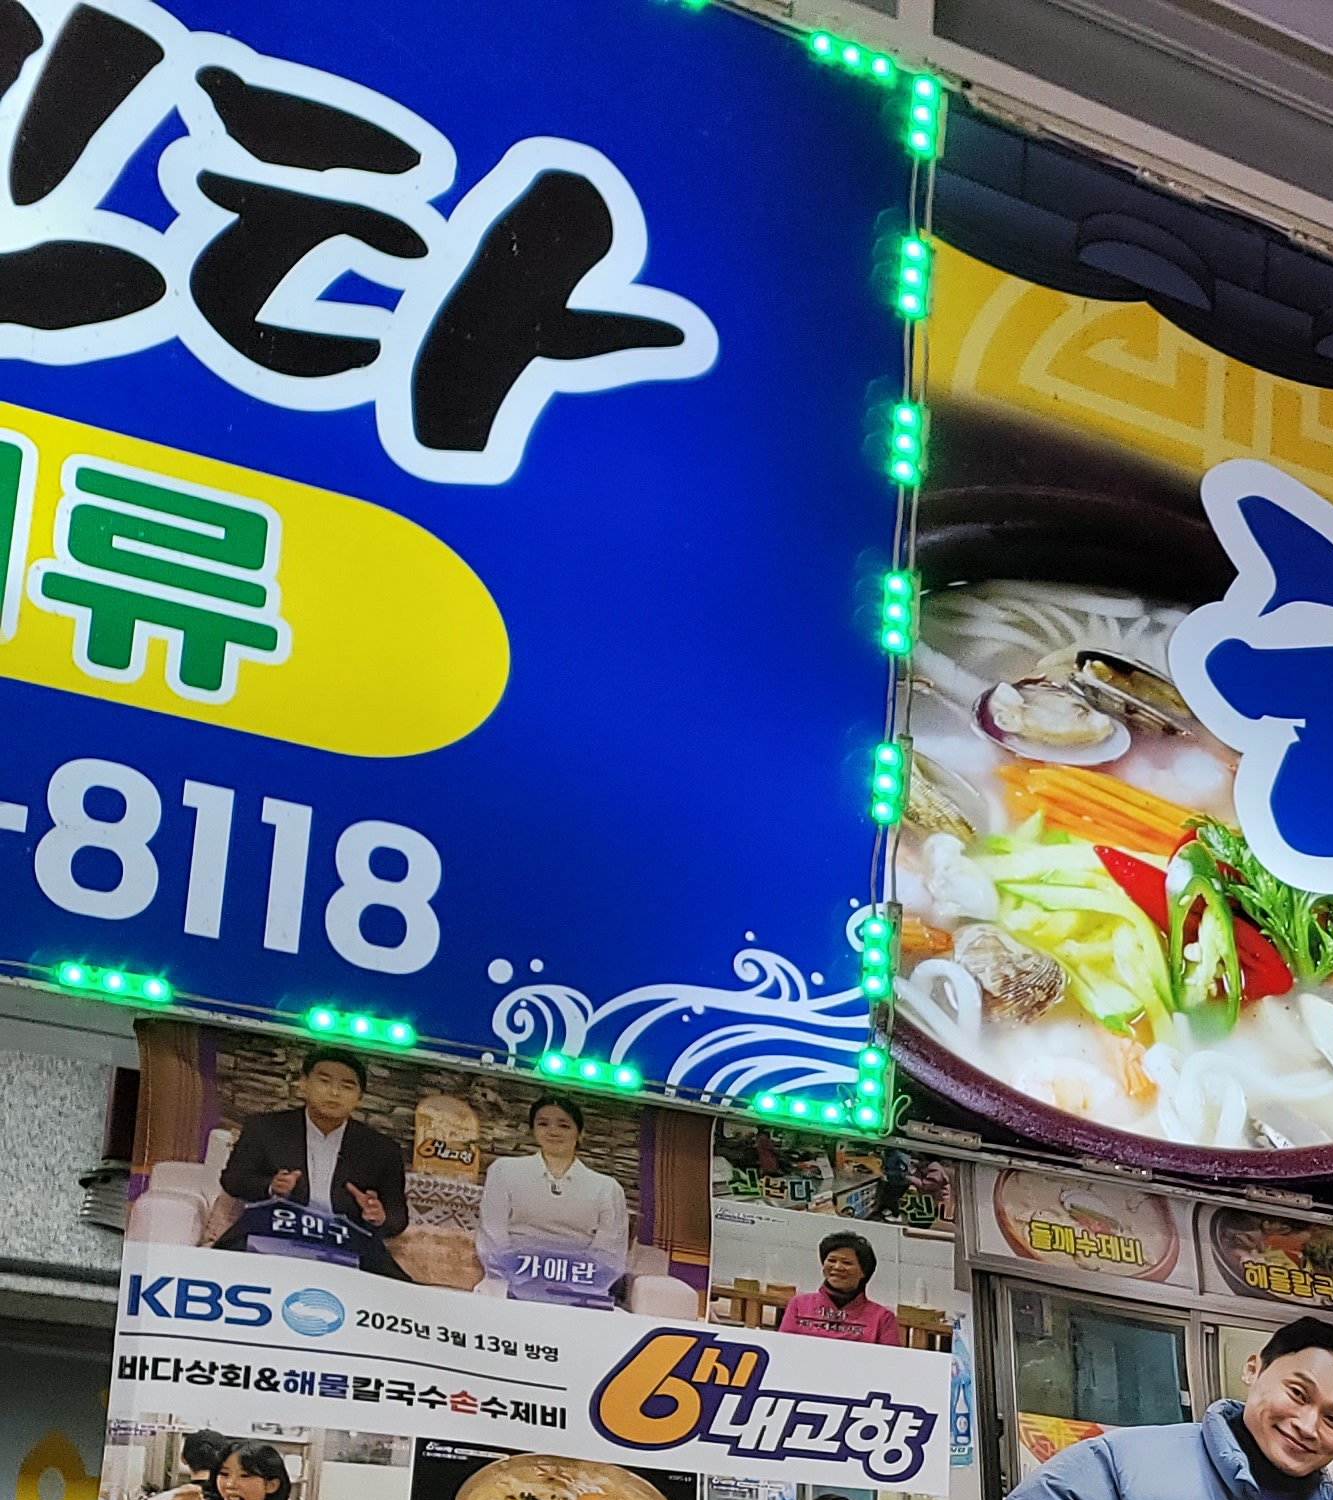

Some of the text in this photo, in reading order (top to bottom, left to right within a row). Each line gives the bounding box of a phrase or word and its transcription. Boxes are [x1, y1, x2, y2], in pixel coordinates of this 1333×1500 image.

[271, 1208, 350, 1245] 윤인구
[1030, 1220, 1143, 1265] 들깨수제비
[514, 1254, 597, 1285] 가애란
[127, 1274, 560, 1363] KBS 2025년 3월 13일 방영
[708, 1393, 923, 1476] 내고향
